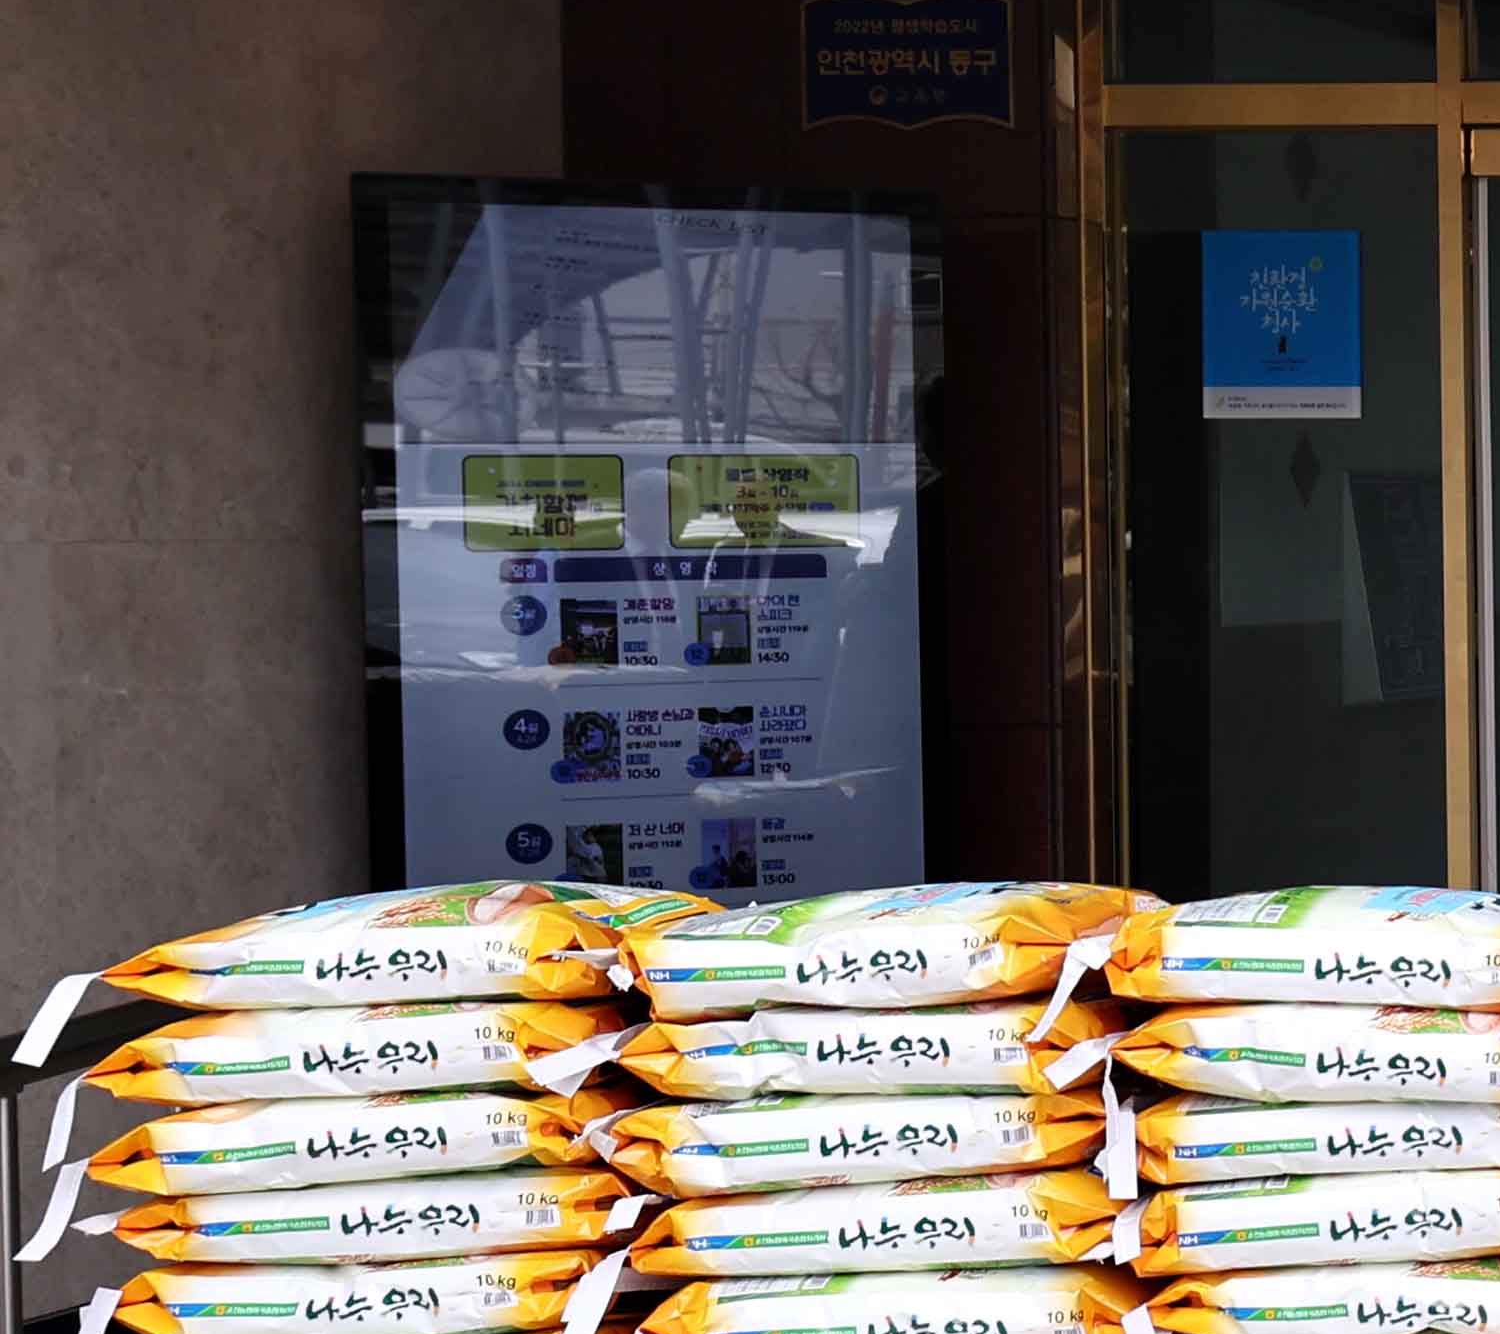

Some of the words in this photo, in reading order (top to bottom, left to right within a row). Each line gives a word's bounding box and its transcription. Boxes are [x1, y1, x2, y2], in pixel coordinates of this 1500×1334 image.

[624, 654, 659, 667] 10:30
[757, 651, 790, 664] 14:30
[627, 767, 661, 780] 10:30
[762, 871, 796, 885] 13:00
[474, 1027, 491, 1039] 10
[497, 1027, 516, 1042] kg
